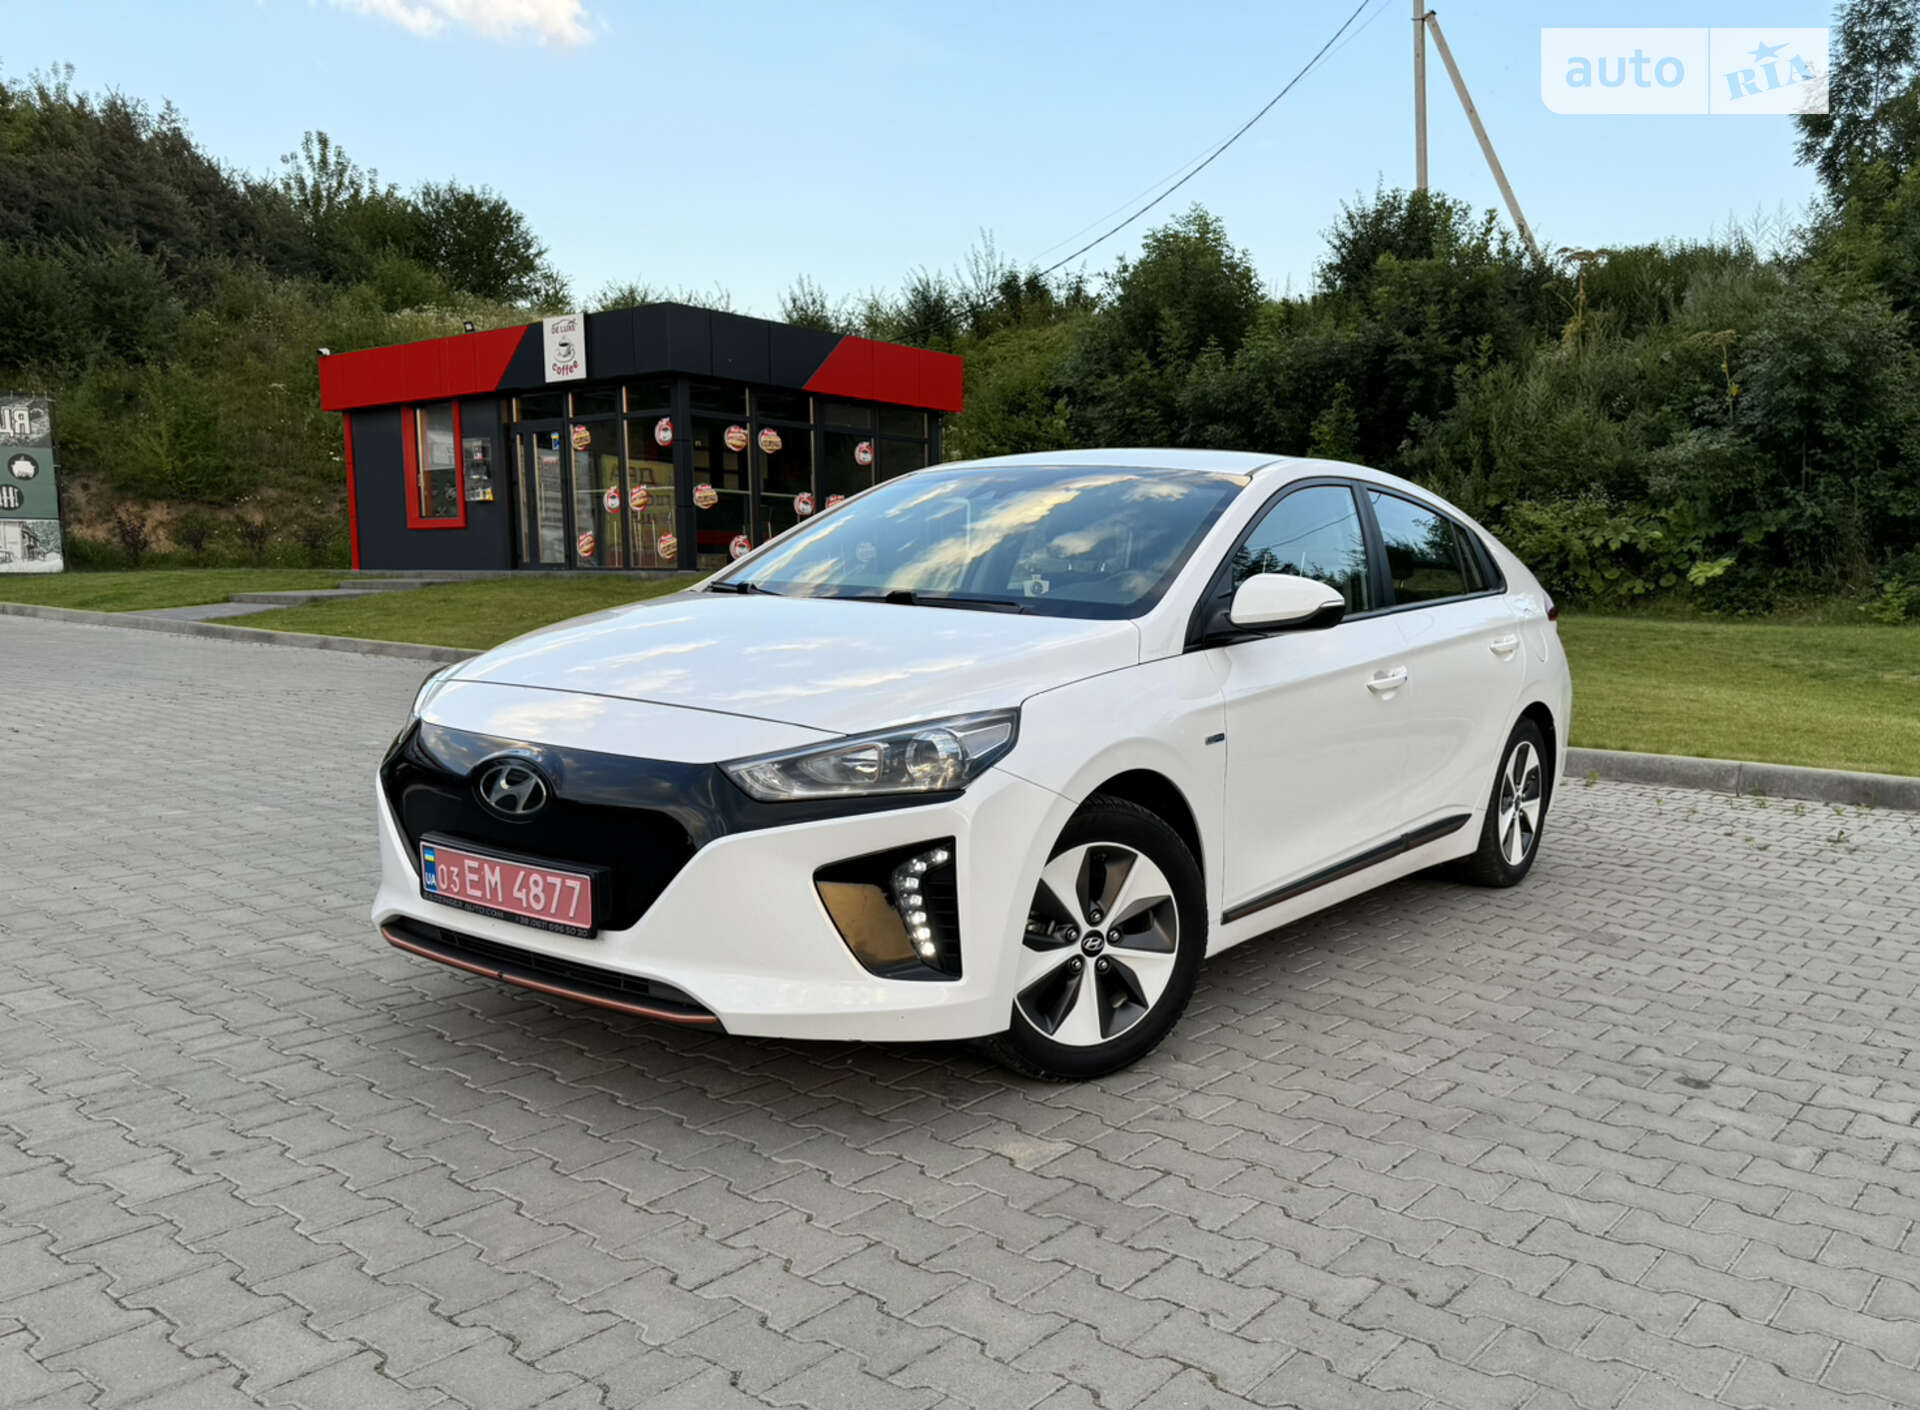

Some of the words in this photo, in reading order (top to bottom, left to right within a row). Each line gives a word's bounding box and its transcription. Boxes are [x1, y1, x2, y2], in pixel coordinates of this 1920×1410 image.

[426, 873, 437, 887] UA
[438, 864, 461, 893] 03
[464, 860, 504, 902] EM
[512, 871, 581, 919] 4877
